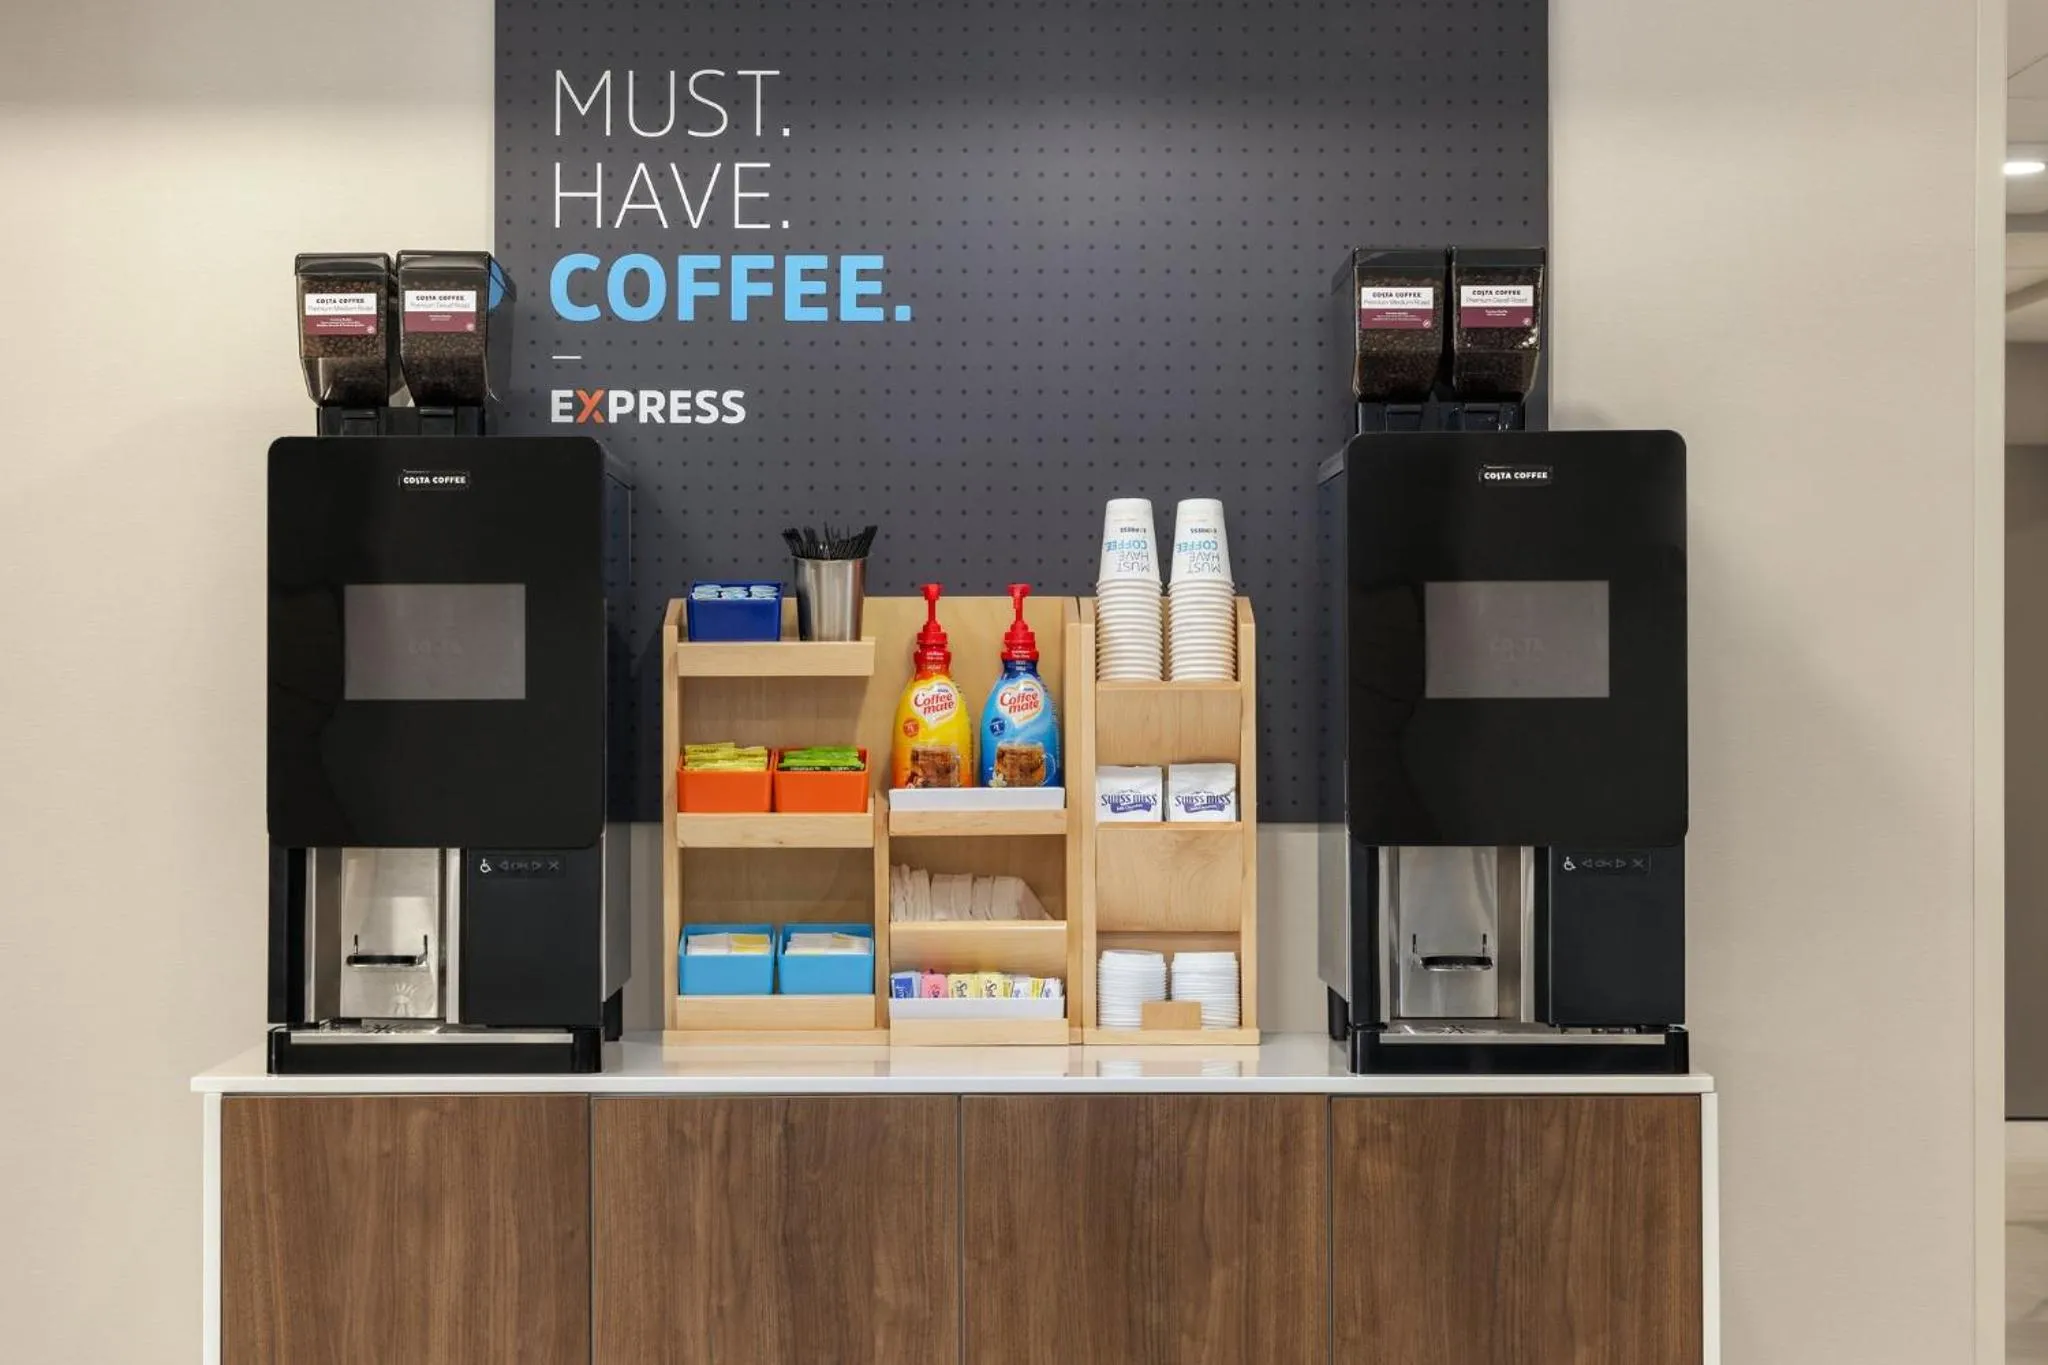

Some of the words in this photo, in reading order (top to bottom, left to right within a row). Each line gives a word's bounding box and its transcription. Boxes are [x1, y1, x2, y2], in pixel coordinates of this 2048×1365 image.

[555, 69, 790, 137] MUST.
[555, 162, 790, 229] HAVE.
[549, 253, 911, 322] COFFEE.
[551, 389, 746, 424] EXPRESS
[403, 476, 430, 485] COSTA
[432, 476, 466, 484] COFFEE
[1484, 471, 1512, 480] COSTA
[1514, 471, 1548, 479] COFFEE
[914, 692, 953, 707] Coffee
[1000, 692, 1038, 706] Coffee
[923, 701, 954, 715] mate
[1008, 700, 1040, 714] mate
